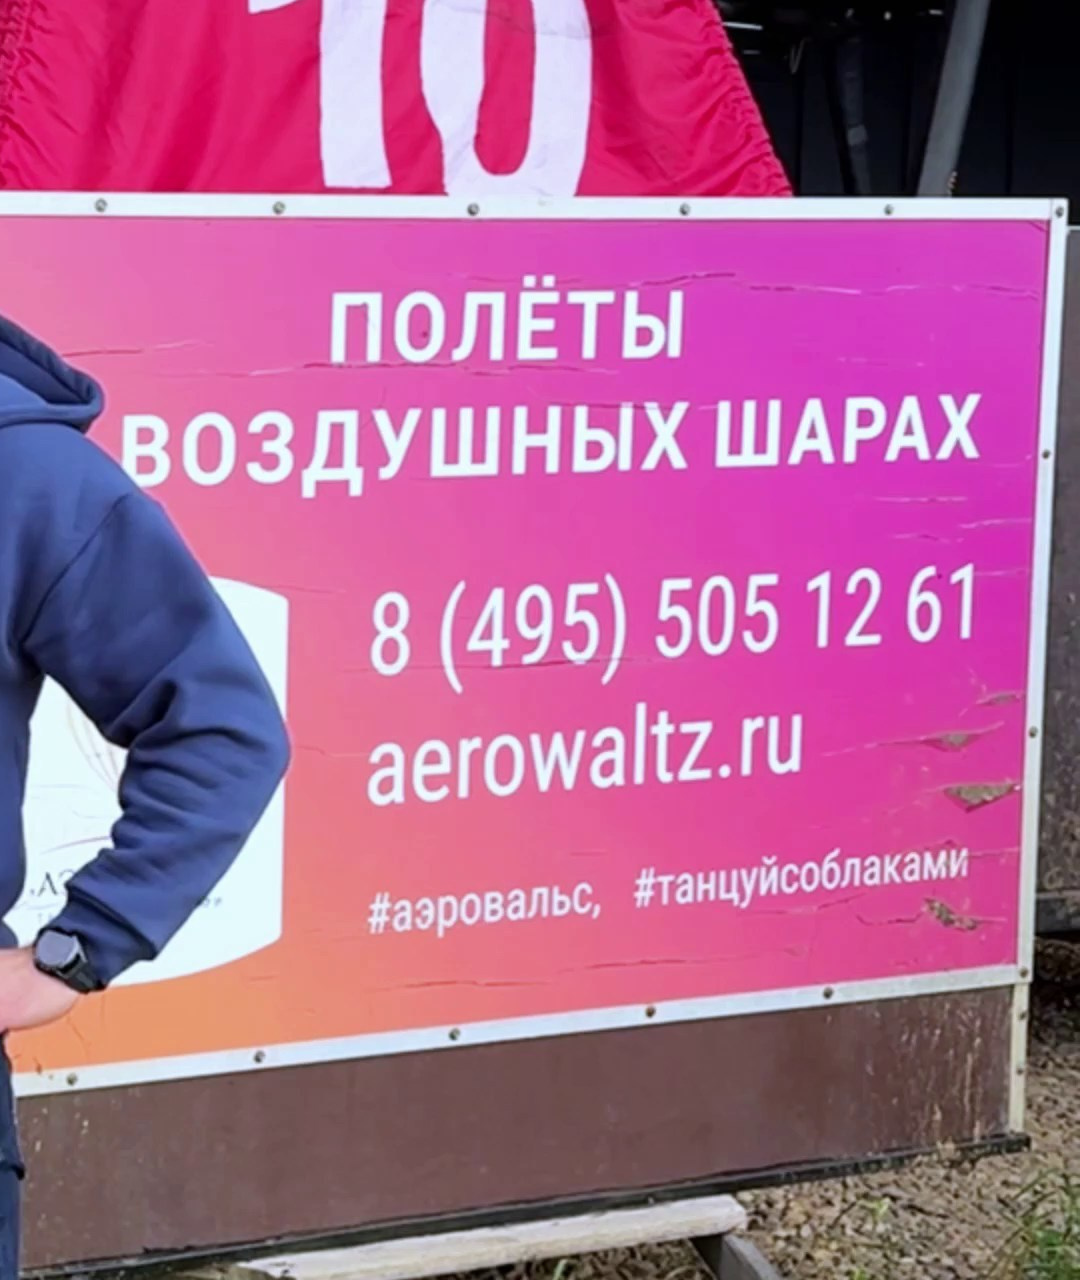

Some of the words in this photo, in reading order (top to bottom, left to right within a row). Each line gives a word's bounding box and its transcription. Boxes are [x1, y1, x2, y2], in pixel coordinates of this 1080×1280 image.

[329, 274, 684, 365] ПОЛЁТЫ
[122, 400, 690, 500] ВОЗДУШНЫХ
[714, 393, 982, 469] ШАРАХ
[369, 590, 411, 677] 8
[439, 573, 627, 695] (495)
[655, 572, 779, 659] 505
[806, 567, 882, 649] 12
[906, 563, 974, 643] 61
[366, 701, 803, 807] aerowaltz.ru
[366, 881, 602, 940] #аэровальс,
[632, 847, 969, 910] #танцуйсоблаками
